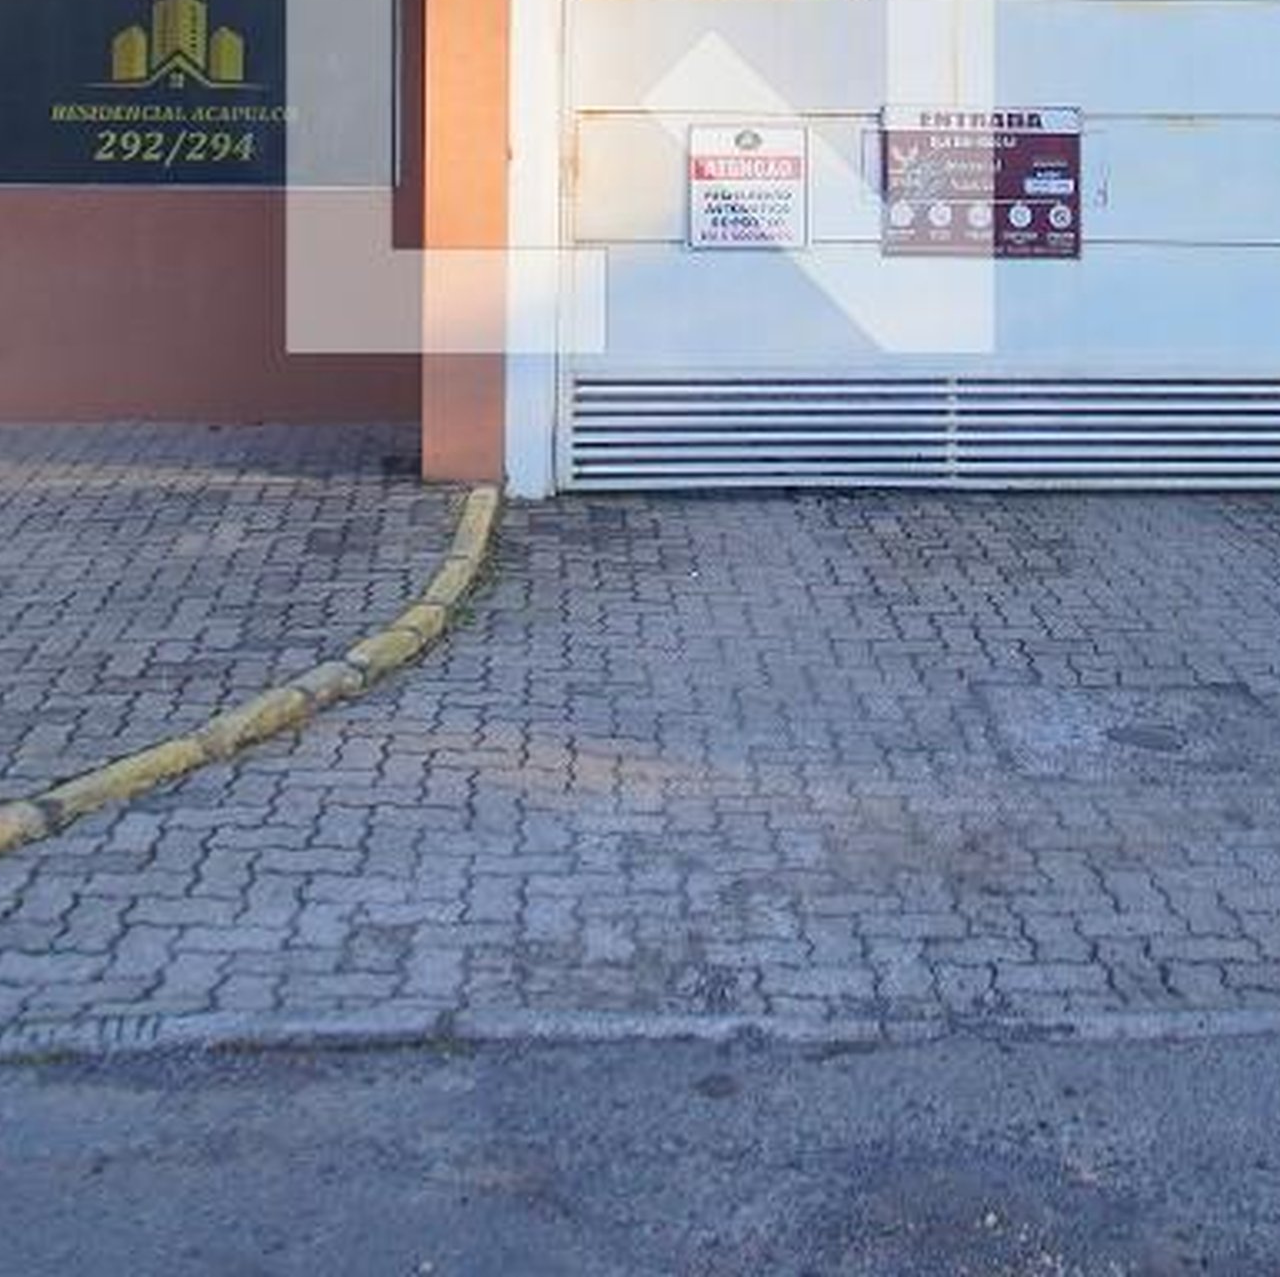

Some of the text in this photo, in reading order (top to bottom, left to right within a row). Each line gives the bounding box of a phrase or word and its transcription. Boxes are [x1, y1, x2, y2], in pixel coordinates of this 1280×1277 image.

[51, 105, 300, 122] RESIDENCIAL ACAPULCO
[920, 111, 1042, 128] ENTRADA
[93, 129, 256, 168] 292/294
